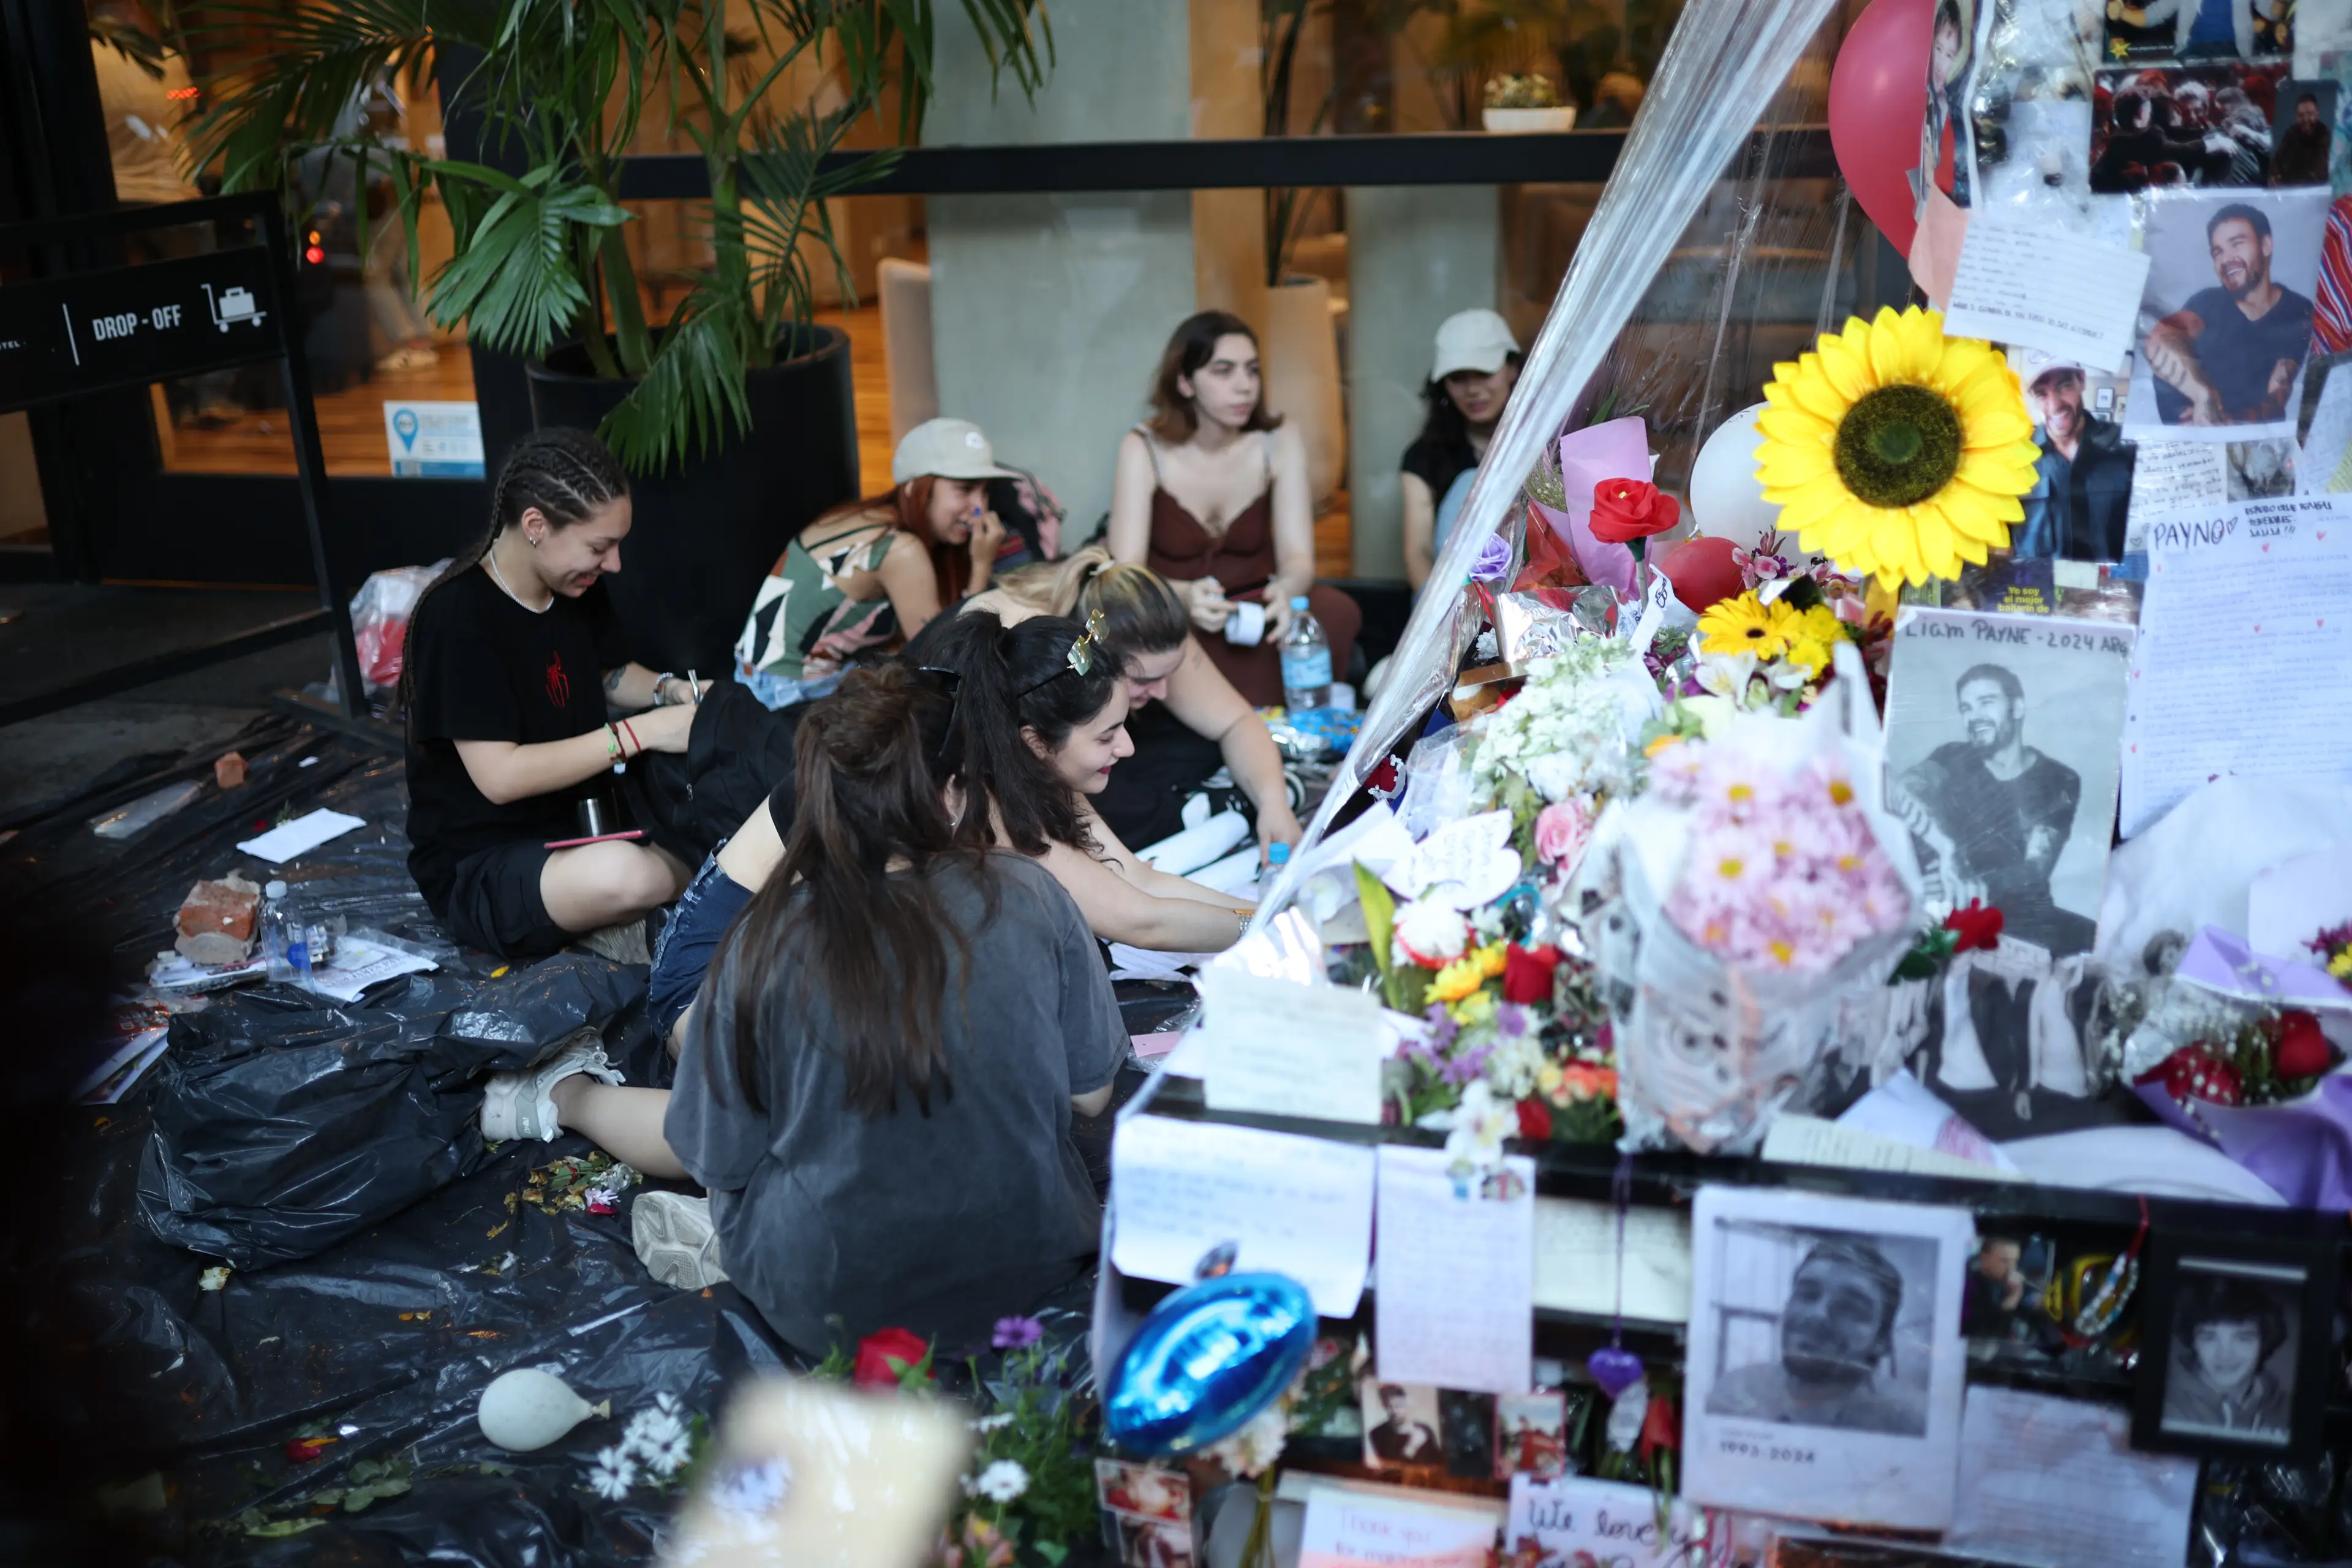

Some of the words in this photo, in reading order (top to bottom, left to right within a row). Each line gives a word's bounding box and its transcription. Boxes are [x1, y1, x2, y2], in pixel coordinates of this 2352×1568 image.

[92, 312, 137, 341] DROP
[152, 304, 182, 331] OFF
[2154, 518, 2225, 550] PAYNO
[2008, 586, 2021, 595] Yo
[2023, 588, 2040, 597] soy
[2016, 597, 2044, 605] mejor
[1905, 617, 1964, 638] Liam
[1972, 619, 2032, 644] PAYNE
[2047, 631, 2095, 650] 2024
[1529, 1499, 1575, 1531] We
[1594, 1509, 1655, 1547] love
